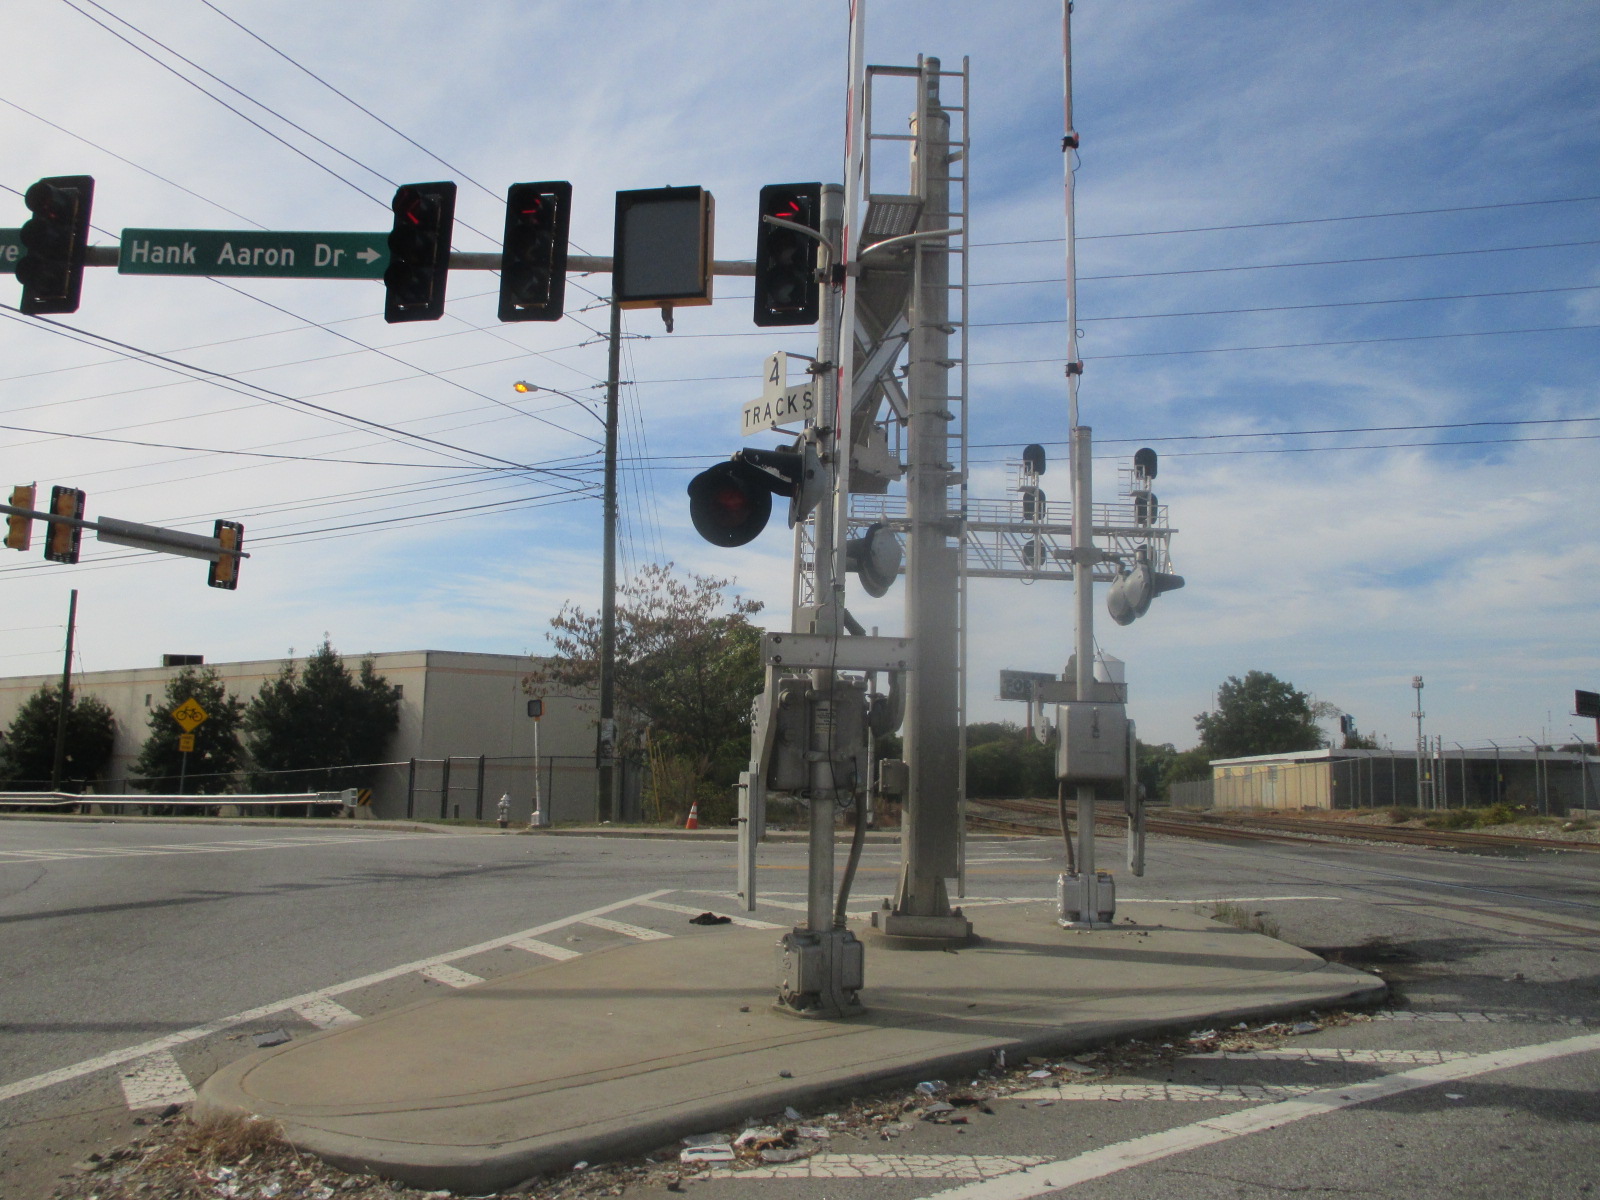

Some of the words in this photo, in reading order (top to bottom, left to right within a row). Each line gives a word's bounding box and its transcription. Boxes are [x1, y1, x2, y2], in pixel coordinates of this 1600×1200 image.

[131, 240, 196, 264] Hank
[217, 242, 295, 266] Aaron
[314, 243, 344, 267] Dr
[769, 361, 780, 386] 4
[745, 391, 813, 427] TRACKS
